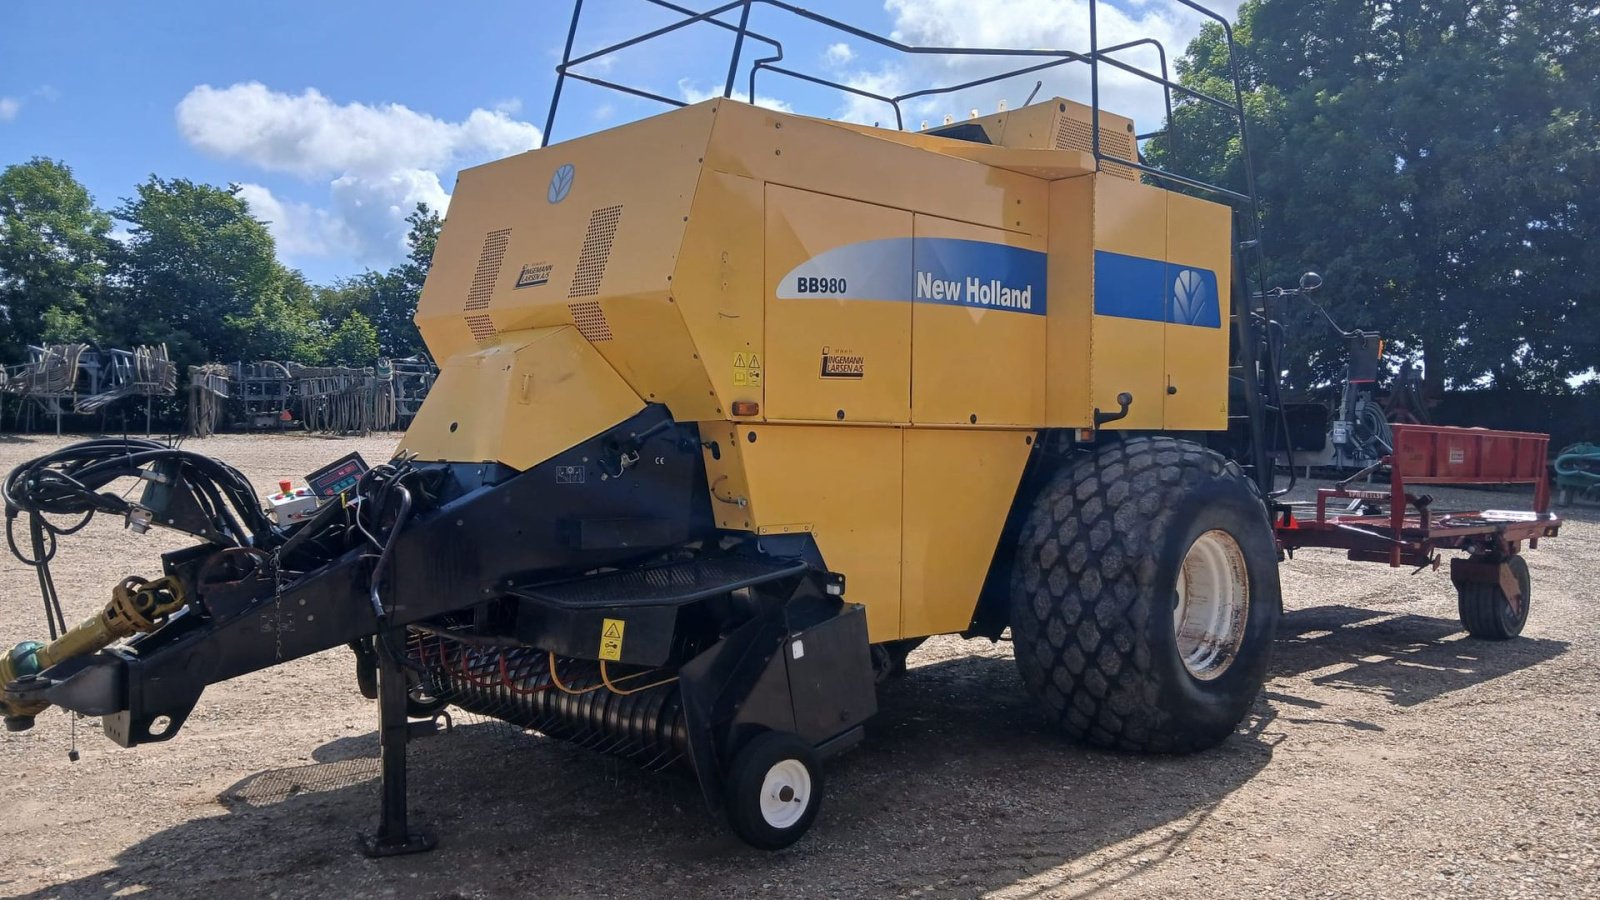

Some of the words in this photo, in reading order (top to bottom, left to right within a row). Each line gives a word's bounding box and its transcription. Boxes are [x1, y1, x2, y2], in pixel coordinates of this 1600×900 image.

[797, 277, 847, 294] BB980
[916, 271, 961, 301] New
[966, 276, 1032, 309] Holland
